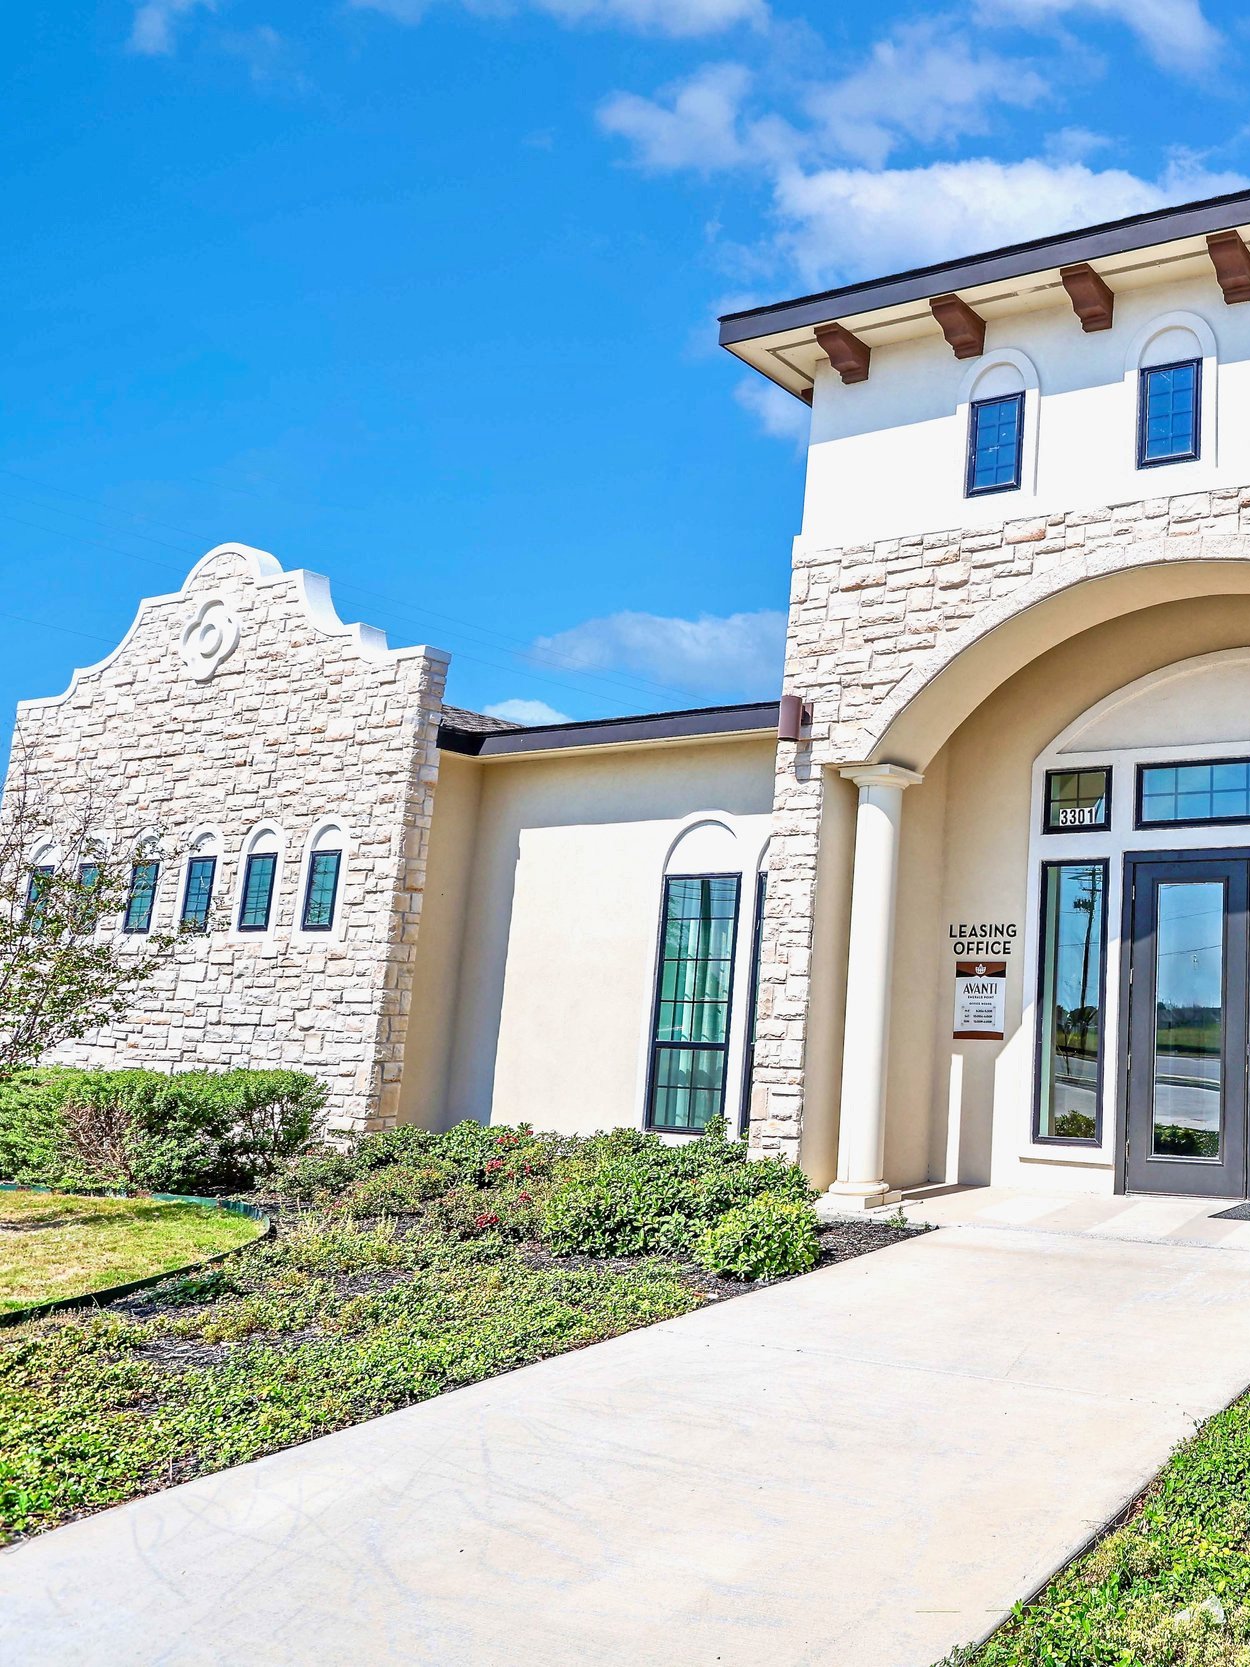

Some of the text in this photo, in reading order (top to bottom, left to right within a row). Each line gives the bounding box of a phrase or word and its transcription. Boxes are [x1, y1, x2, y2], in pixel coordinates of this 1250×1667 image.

[1061, 808, 1094, 825] 3301
[949, 924, 1017, 938] LEASING
[953, 941, 1011, 955] OFFICE
[963, 983, 997, 994] AVANTI
